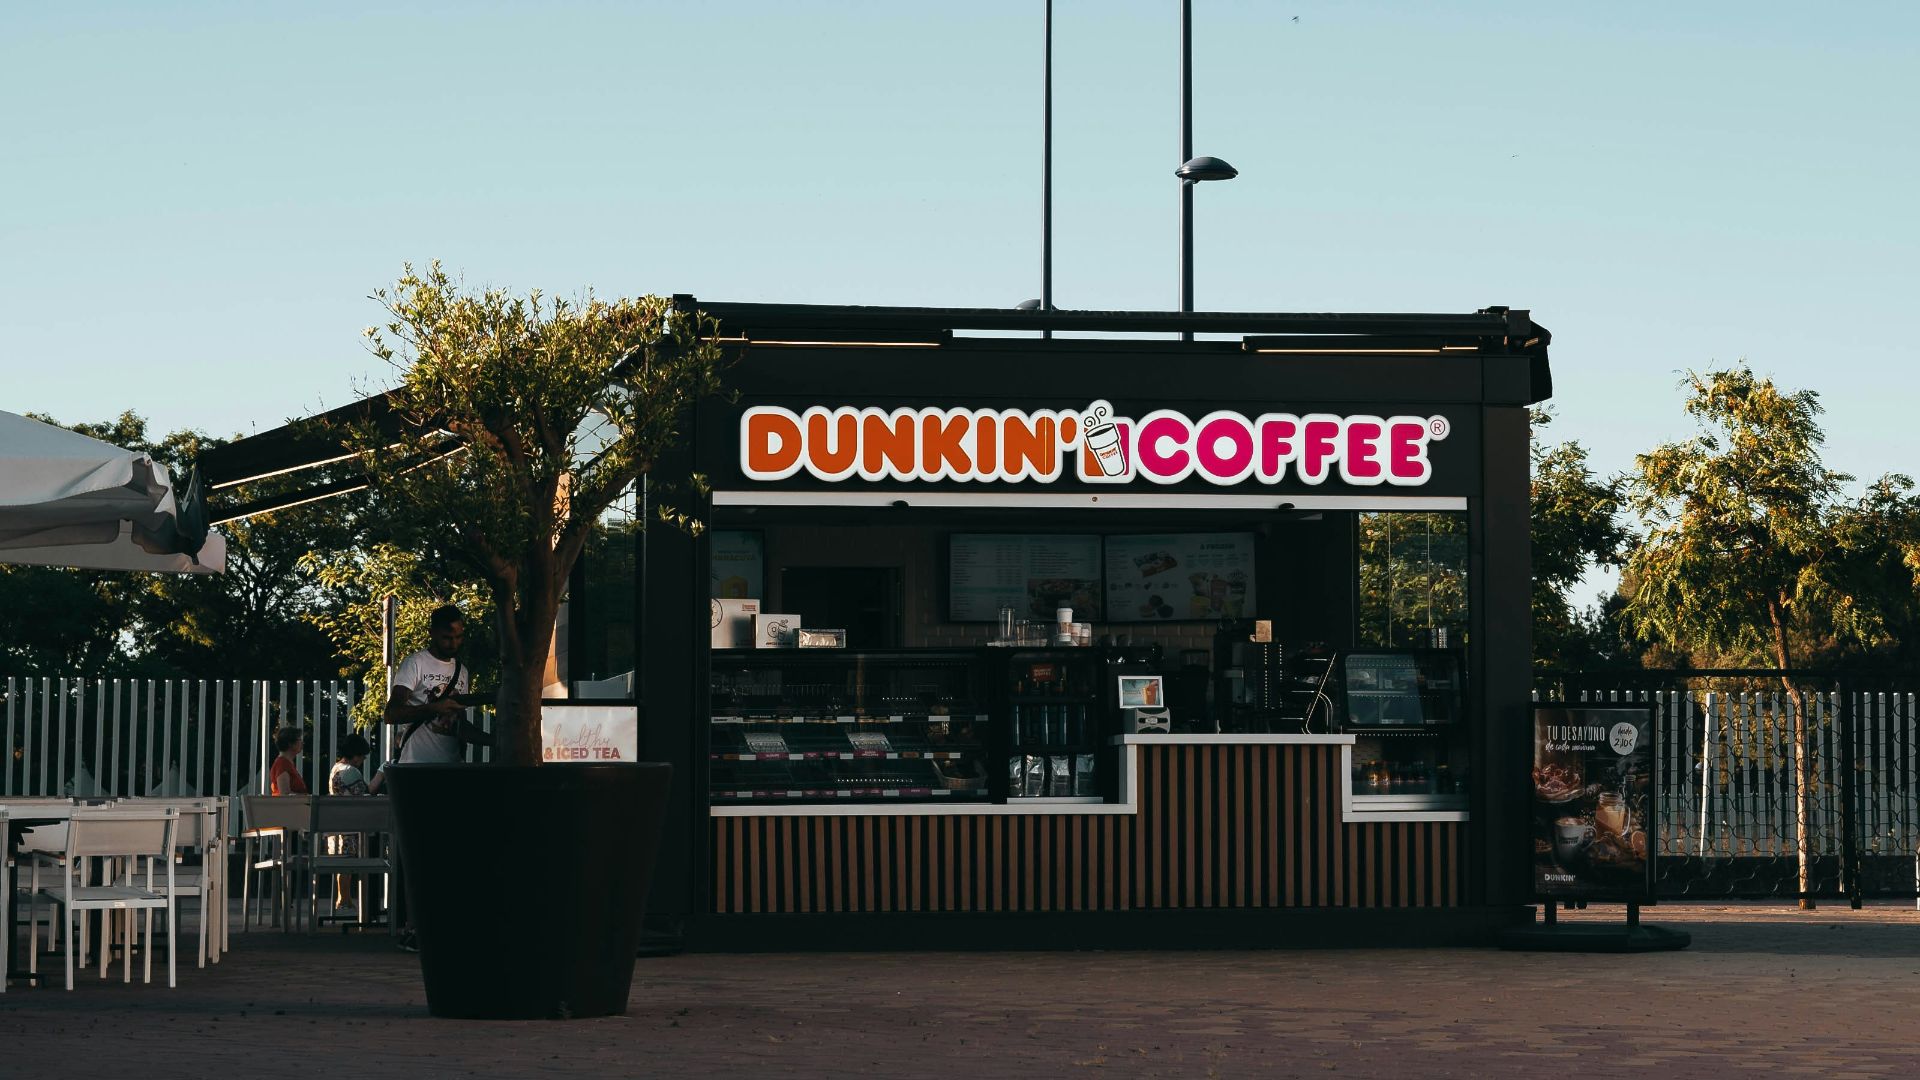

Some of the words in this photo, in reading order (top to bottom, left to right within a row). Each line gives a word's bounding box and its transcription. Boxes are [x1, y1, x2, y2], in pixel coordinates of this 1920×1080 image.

[748, 412, 1077, 478] DUNKIN'
[1547, 726, 1558, 741] TU
[1561, 726, 1605, 742] DESAYUNO
[543, 747, 553, 760] &
[556, 747, 589, 760] ICED
[592, 747, 621, 760] TEA
